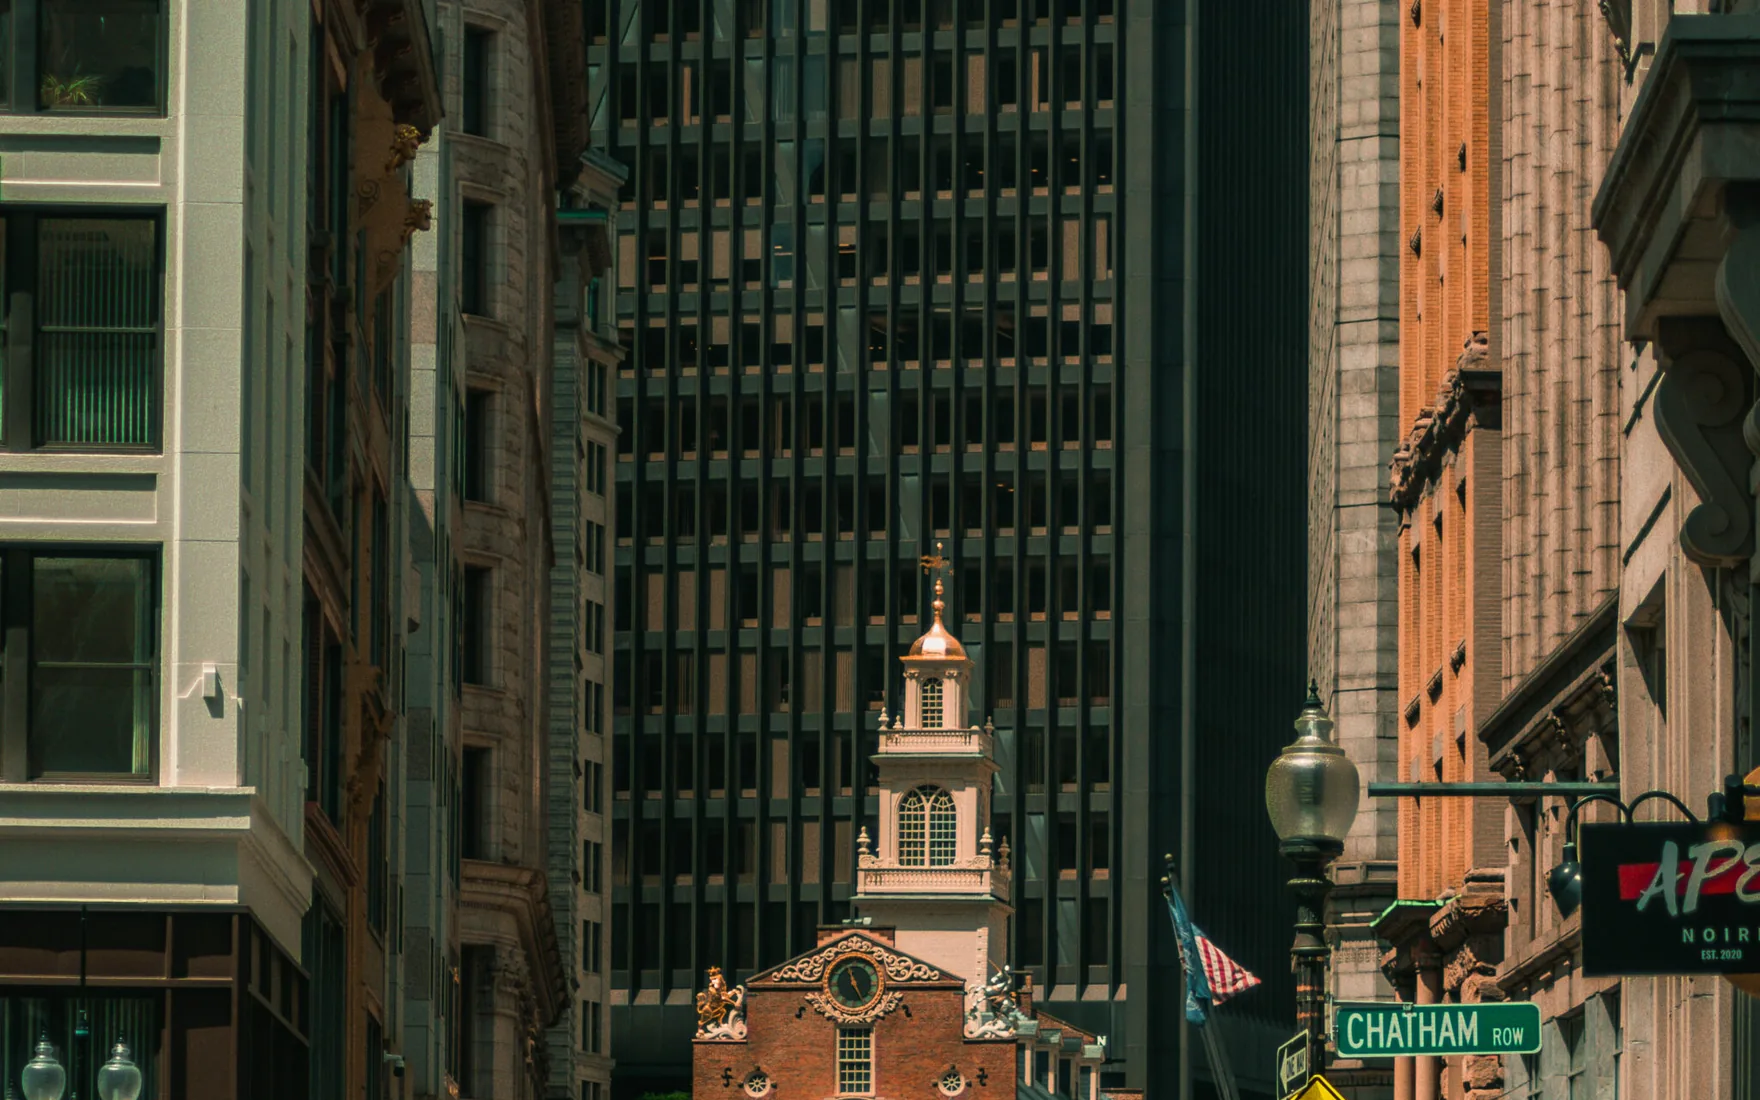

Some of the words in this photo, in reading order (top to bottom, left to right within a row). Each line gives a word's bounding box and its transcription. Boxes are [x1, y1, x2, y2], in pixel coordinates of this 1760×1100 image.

[1682, 927, 1760, 943] NOIR
[1700, 949, 1718, 960] EST.
[1720, 949, 1742, 960] 2020
[1347, 1011, 1478, 1049] CHATHAM
[1492, 1027, 1524, 1046] ROW
